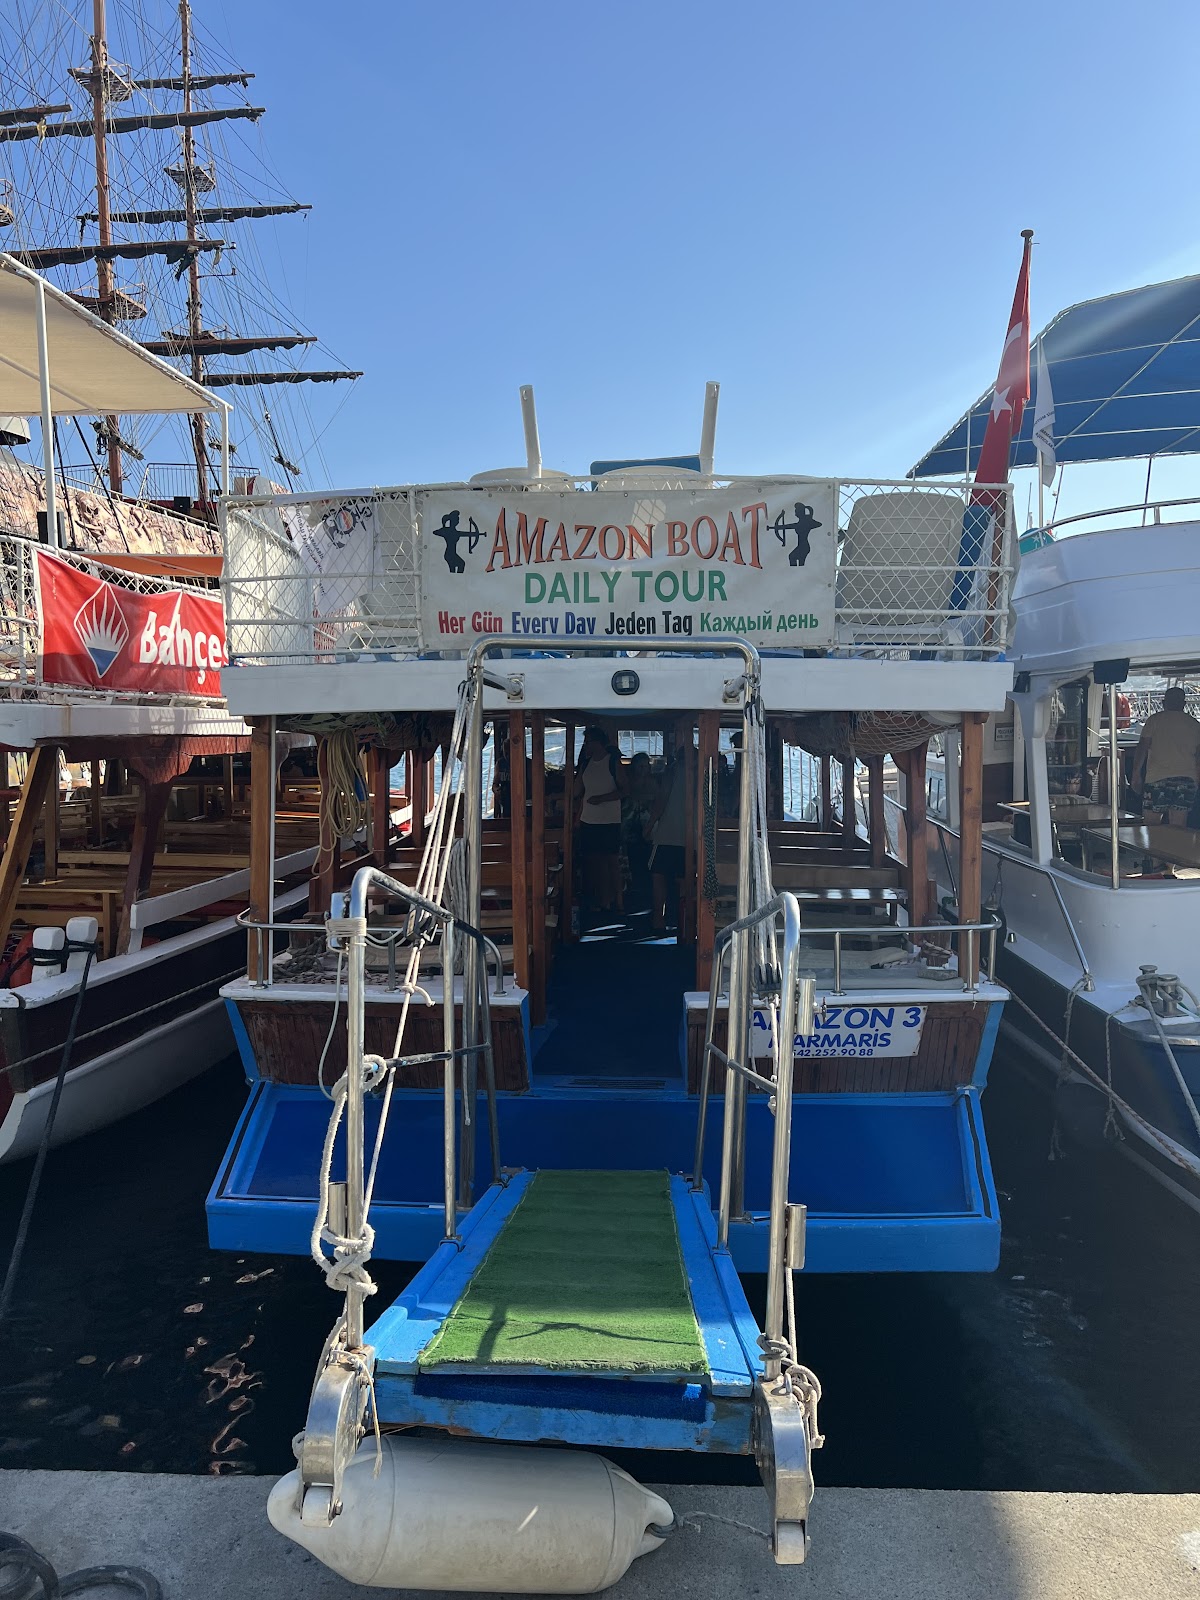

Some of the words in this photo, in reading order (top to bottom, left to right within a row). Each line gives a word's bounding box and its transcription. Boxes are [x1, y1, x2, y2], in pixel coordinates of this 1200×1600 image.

[485, 507, 656, 573] AMAZON
[665, 501, 769, 569] BOAT
[525, 571, 622, 604] DAILY
[632, 570, 728, 603] TOUR
[438, 611, 466, 634] Her
[471, 611, 503, 633] Gün
[605, 611, 657, 635] Jeden
[662, 610, 693, 636] Tag
[700, 609, 773, 634] Каждый
[776, 613, 819, 633] день
[753, 1007, 895, 1030] AZON
[902, 1007, 921, 1028] 3
[768, 1028, 892, 1048] ARMARİS
[858, 1048, 874, 1057] 88
